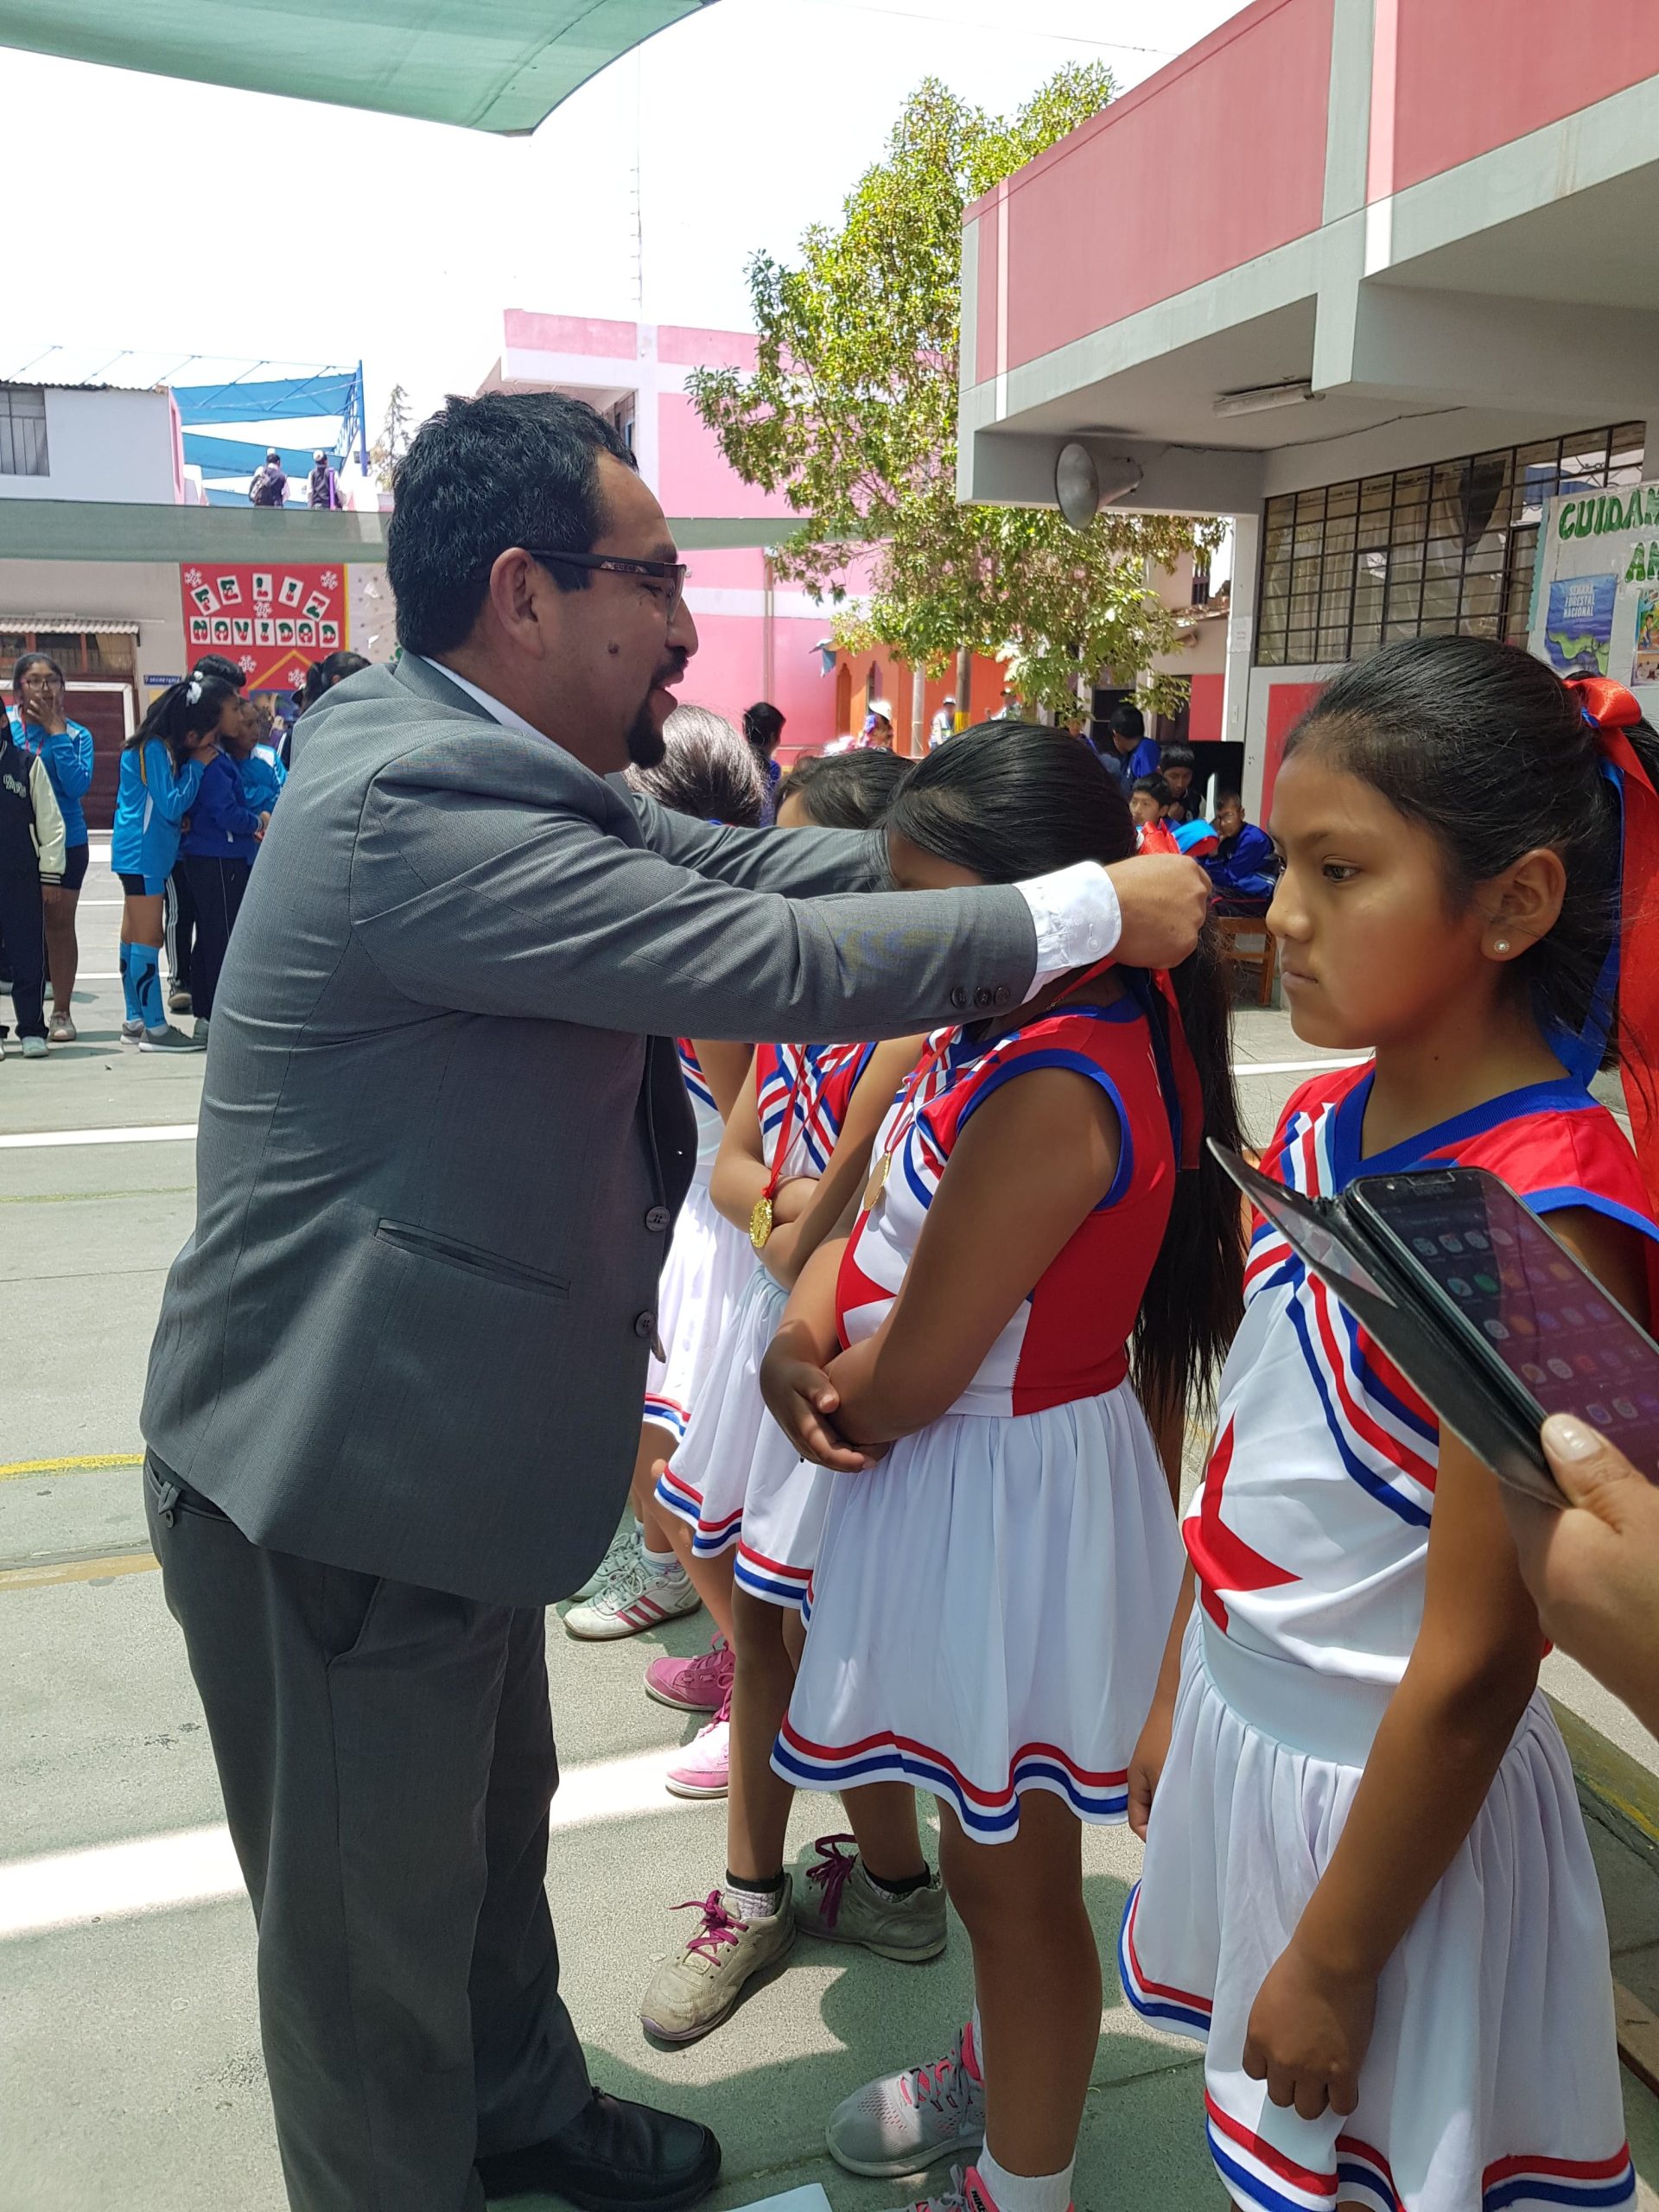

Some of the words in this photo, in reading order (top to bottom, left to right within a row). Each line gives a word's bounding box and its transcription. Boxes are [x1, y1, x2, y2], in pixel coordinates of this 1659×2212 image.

[194, 576, 326, 619] FELIZ
[1565, 594, 1594, 607] FORESTAL
[1563, 606, 1593, 618] NACIONAL
[193, 620, 336, 644] NAVIDAD
